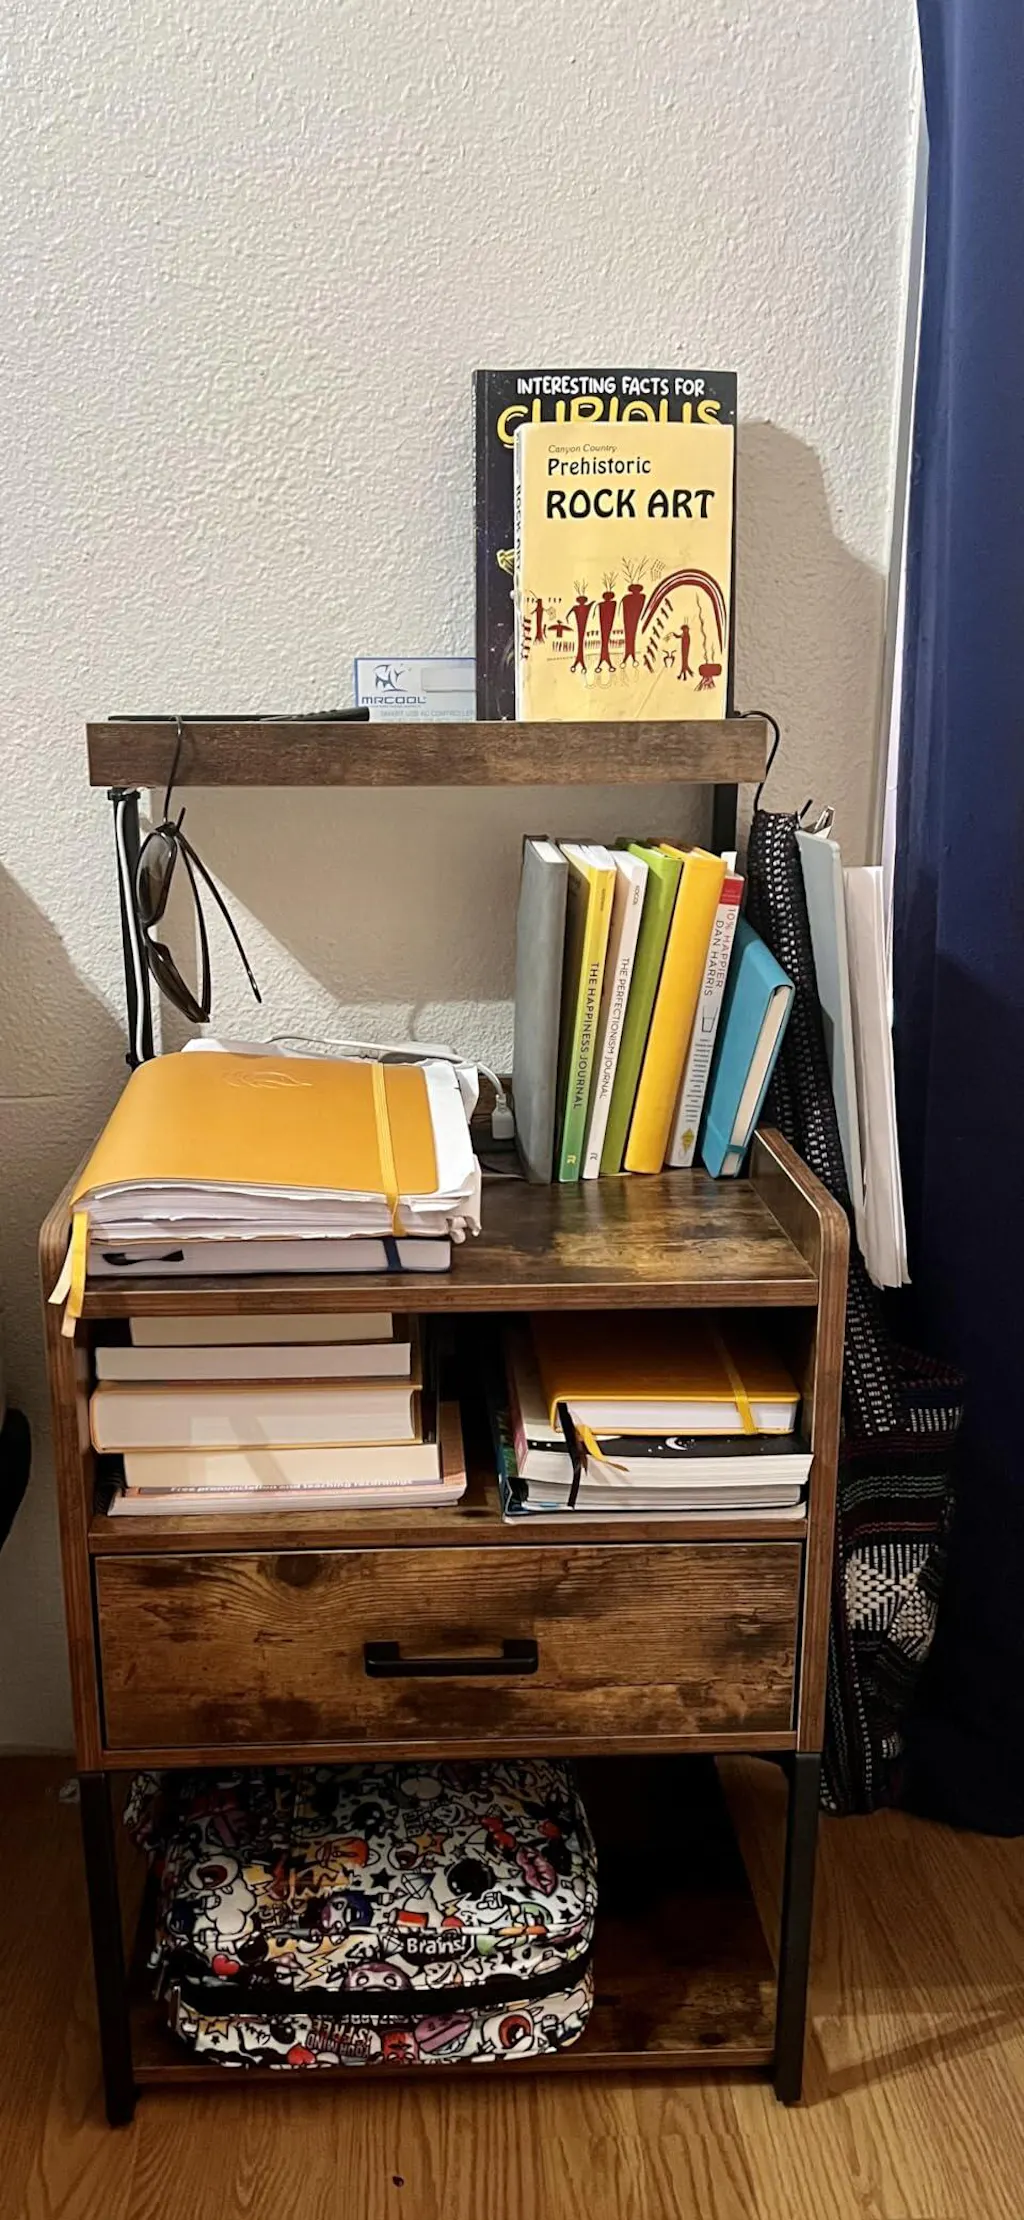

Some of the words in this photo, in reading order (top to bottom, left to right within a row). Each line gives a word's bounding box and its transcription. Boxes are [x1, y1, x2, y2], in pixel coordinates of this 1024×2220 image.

[517, 375, 617, 395] INTERESTING
[621, 376, 670, 396] FACTS
[675, 378, 705, 397] FOR
[548, 444, 581, 453] Canyon
[582, 444, 617, 453] Country
[547, 456, 652, 476] Prehistoric
[546, 488, 636, 519] ROCK
[647, 488, 715, 519] ART
[361, 696, 425, 704] MRCOOL
[714, 919, 724, 945] DAN
[620, 957, 630, 977] THE
[704, 946, 719, 997] HARRIS
[714, 933, 733, 988] HAPPIER
[588, 962, 600, 985] THE
[579, 986, 597, 1052] HAPPINESS
[607, 976, 627, 1053] PERFECTIONISM
[572, 1052, 588, 1109] JOURNAL
[599, 1054, 615, 1100] JOURNAL
[406, 1935, 467, 1955] Brains!
[312, 2019, 356, 2042] FREE
[306, 2033, 339, 2052] MIND
[339, 2043, 370, 2059] YOUR
